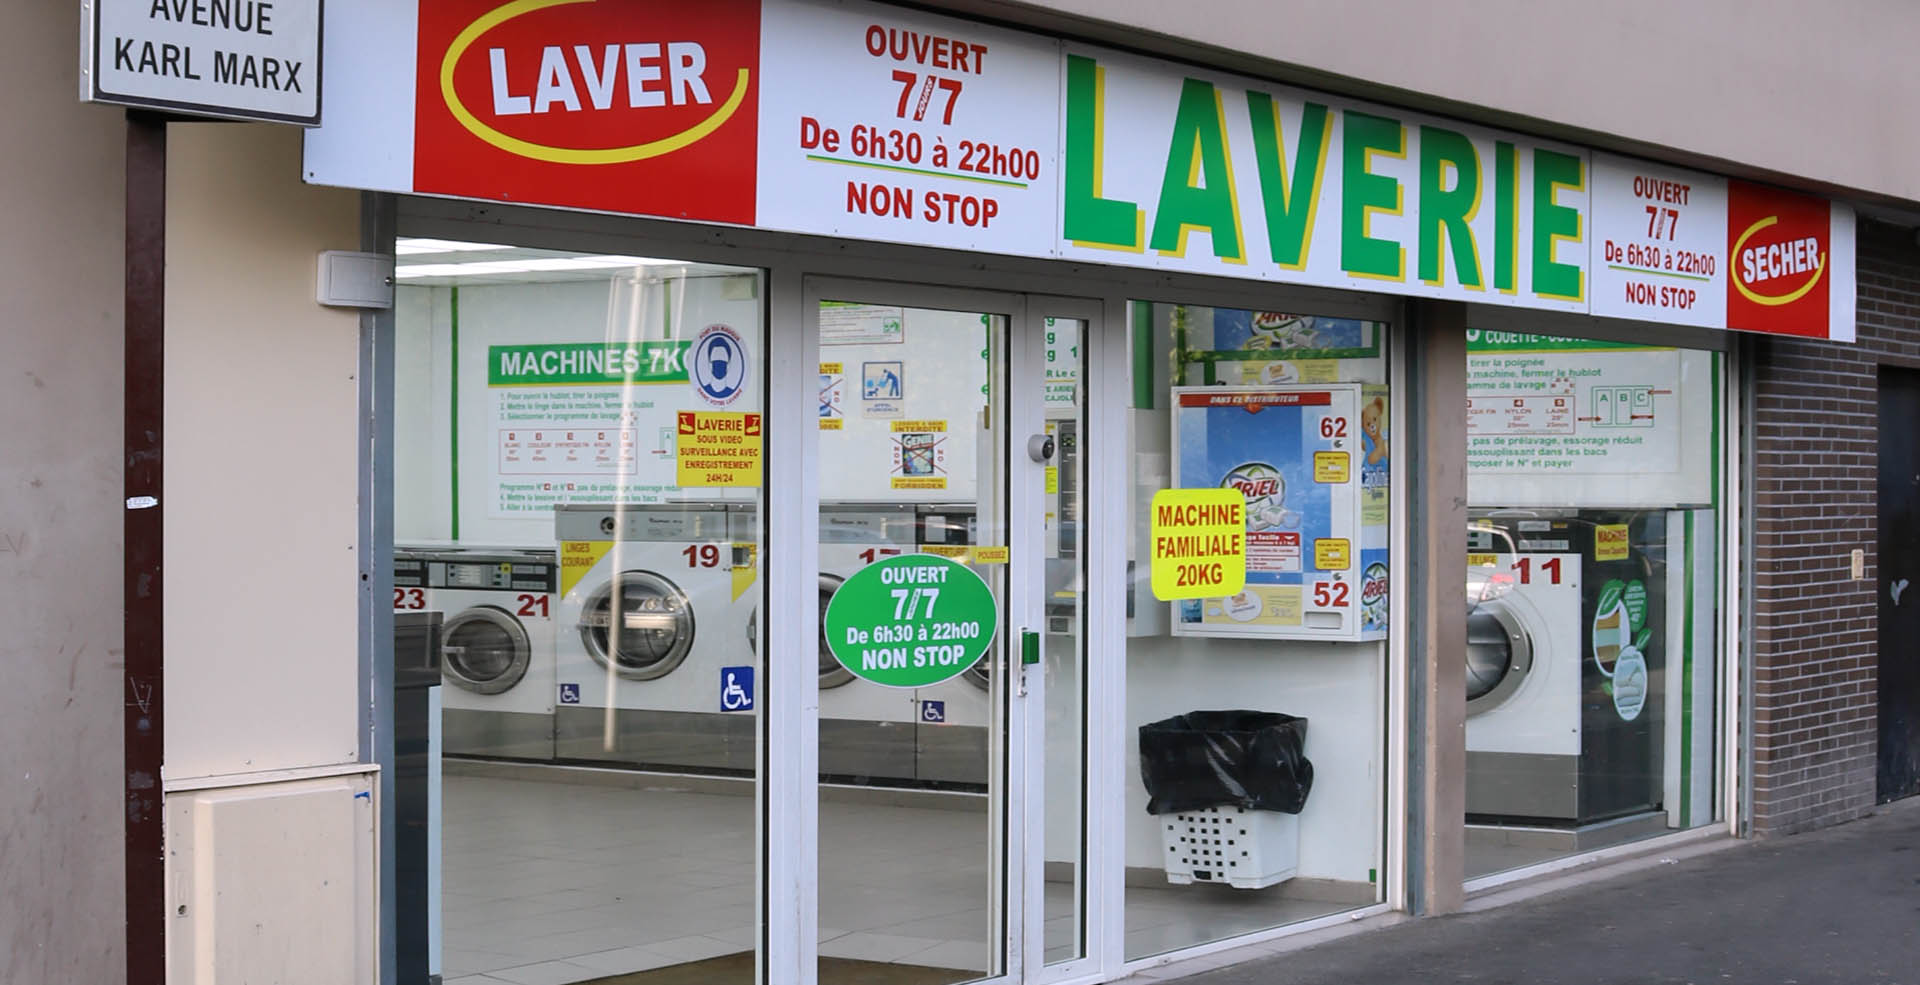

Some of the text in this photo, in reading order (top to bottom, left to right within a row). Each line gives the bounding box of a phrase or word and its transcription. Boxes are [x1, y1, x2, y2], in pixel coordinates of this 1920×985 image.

[150, 0, 273, 36] AVENUE
[865, 25, 988, 75] OUVERT
[115, 37, 303, 94] KARL MARX
[489, 41, 712, 116] LAVER
[801, 117, 1040, 181] De 6h30 à 22h00
[1064, 53, 1586, 303] LAVERIE
[1633, 176, 1691, 206] OUVERT
[846, 181, 999, 228] NON STOP
[1605, 240, 1716, 276] De 6h30 à 22h00
[1742, 237, 1820, 283] SECHER
[1625, 281, 1697, 310] NON STOP
[1522, 367, 1554, 378] fermer
[1569, 366, 1602, 377] hublot
[1514, 378, 1546, 391] lavage
[1600, 393, 1609, 402] A
[1619, 393, 1628, 402] B
[1636, 393, 1646, 402] C
[697, 419, 743, 431] LAVERIE
[1320, 416, 1348, 438] 62
[697, 435, 743, 444] SOUS VIDEO
[1613, 435, 1643, 445] réduit
[680, 447, 759, 457] SURVEILLANCE AVEC
[1584, 447, 1608, 456] bacs
[685, 461, 753, 470] ENREGISTREMENT
[1544, 459, 1573, 469] payer
[1231, 479, 1279, 498] ARIEL
[1158, 504, 1240, 527] MACHINE
[565, 542, 590, 553] LINGES
[682, 544, 720, 568] 19
[859, 548, 901, 564] 1
[1157, 535, 1240, 558] FAMILIALE
[562, 556, 595, 568] COURANT
[880, 566, 949, 584] OUVERT
[1177, 562, 1223, 587] 20KG
[394, 588, 426, 610] 23
[517, 594, 550, 617] 21
[890, 588, 940, 620] 7/7
[1313, 582, 1349, 607] 52
[846, 621, 980, 645] De 6h30 à 22h00
[862, 645, 965, 670] NON STOP
